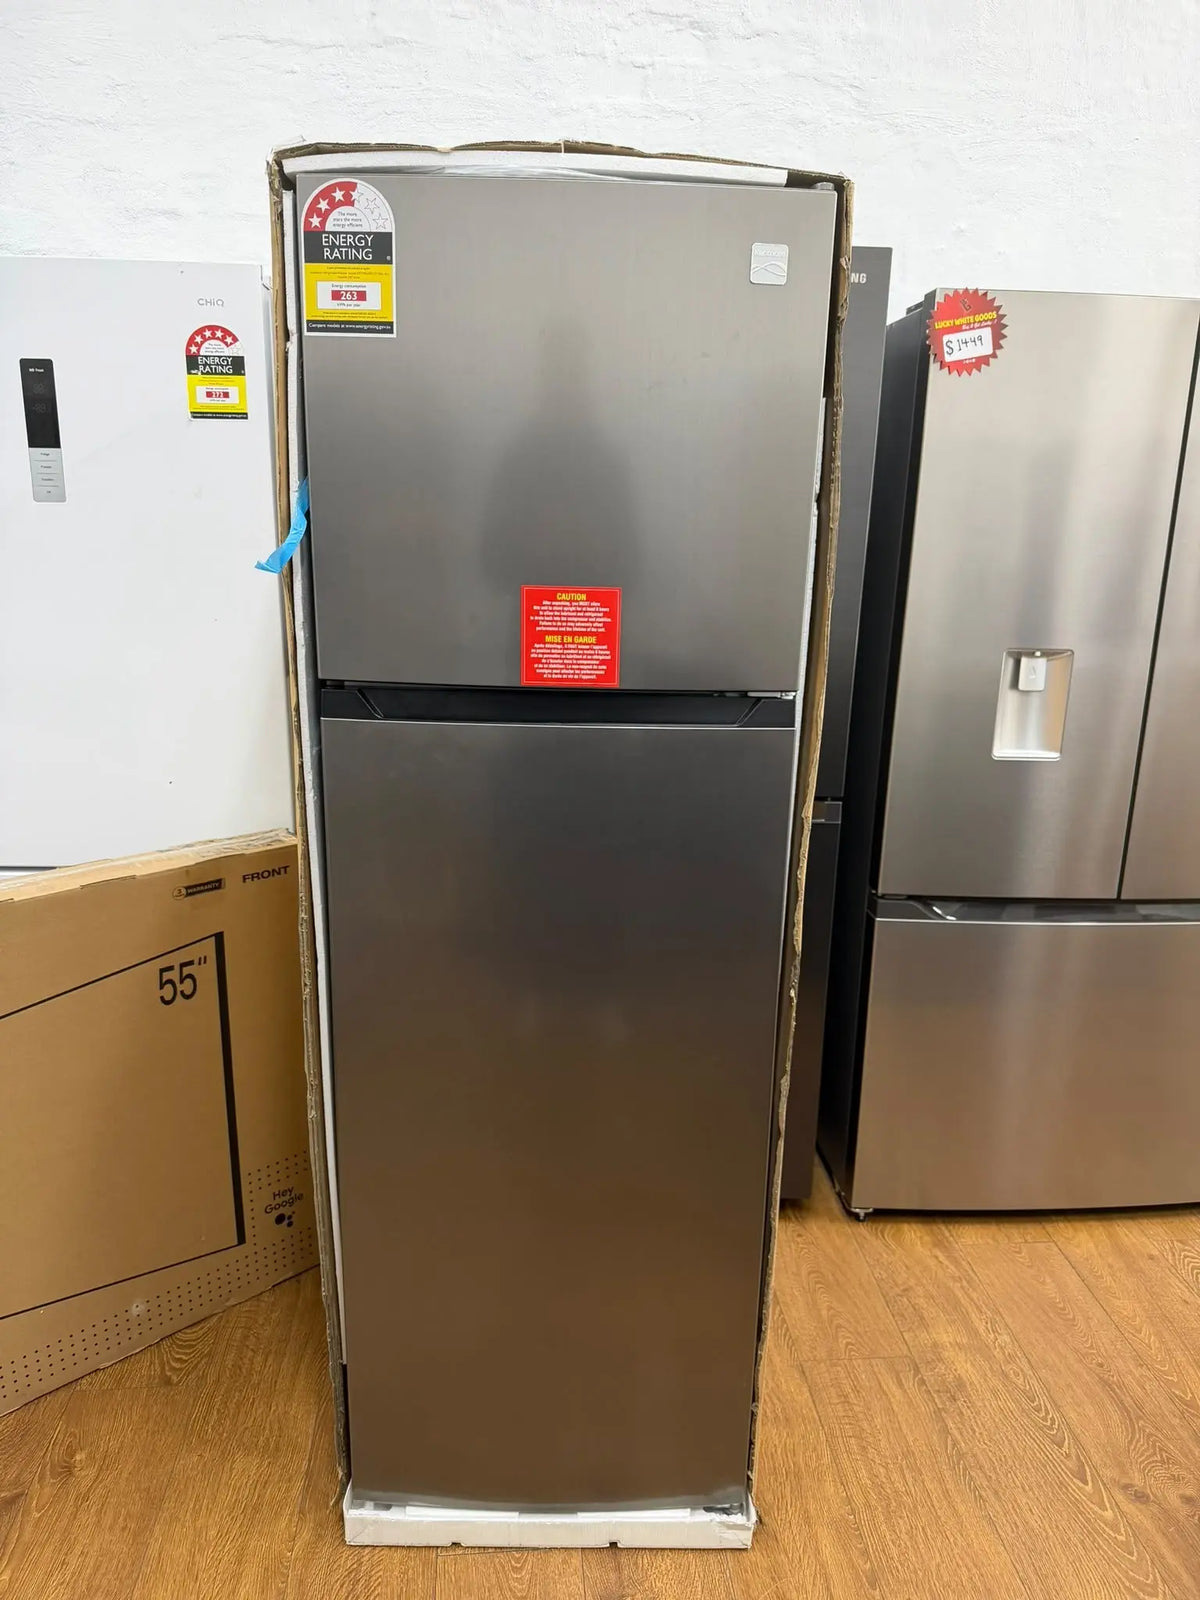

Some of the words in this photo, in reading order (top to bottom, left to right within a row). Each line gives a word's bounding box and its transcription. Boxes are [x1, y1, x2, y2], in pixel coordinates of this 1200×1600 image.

[322, 234, 374, 247] ENERGY
[324, 248, 373, 260] RATING
[340, 291, 357, 300] 263
[934, 319, 954, 329] LUCKY
[954, 315, 975, 326] WHITE
[974, 311, 997, 322] GOODS
[198, 356, 233, 365] ENERGY
[199, 365, 233, 374] RATING
[556, 593, 587, 601] CAUTION
[545, 635, 562, 643] MISE
[563, 635, 572, 643] EN
[574, 636, 597, 644] GARDE
[242, 865, 290, 884] FRONT
[187, 882, 220, 894] WARRANTY
[159, 955, 207, 1006] 55"
[273, 1186, 294, 1201] Hey
[264, 1193, 304, 1214] Google
